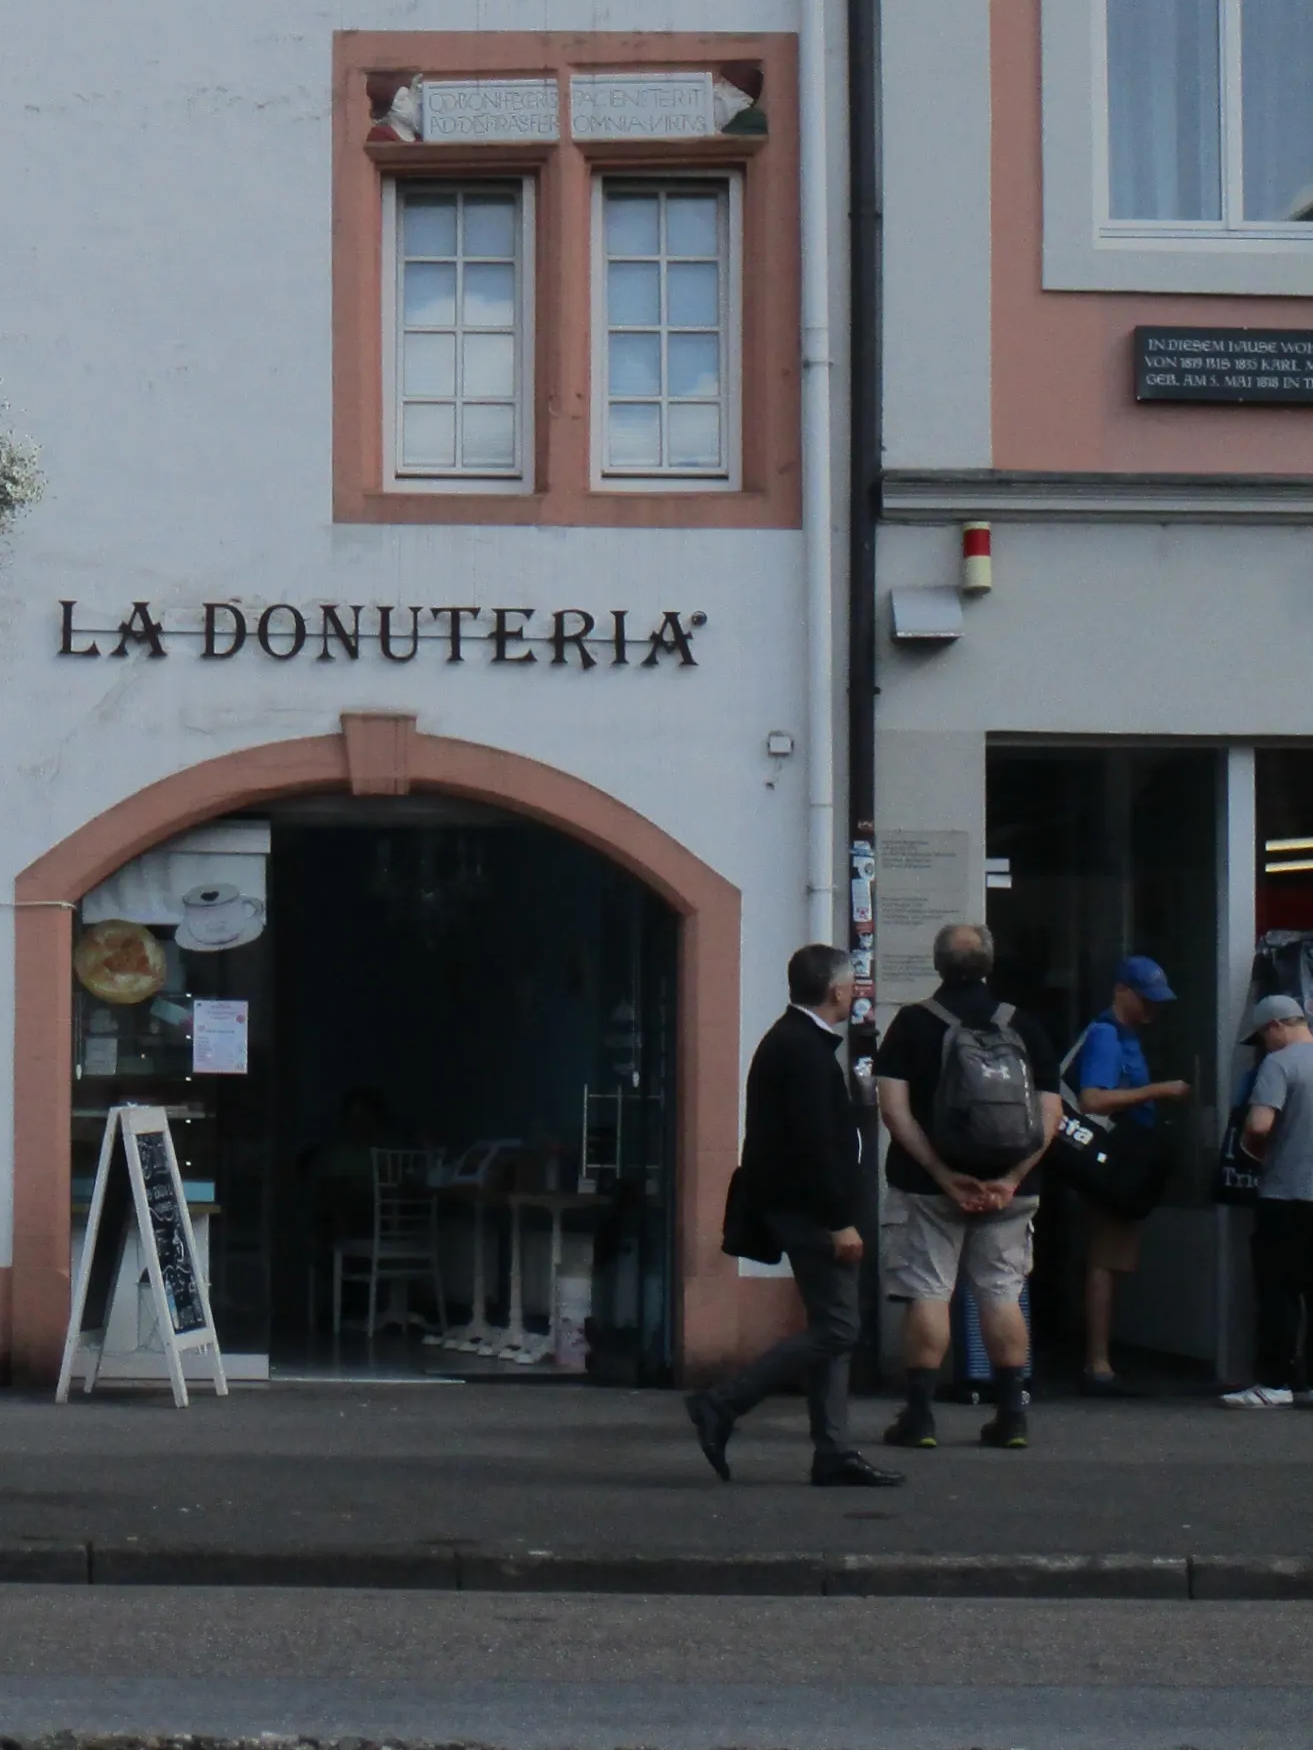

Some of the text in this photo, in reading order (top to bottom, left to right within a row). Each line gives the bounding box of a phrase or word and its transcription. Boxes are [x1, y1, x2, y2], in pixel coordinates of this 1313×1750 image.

[1148, 338, 1166, 351] IN
[1168, 338, 1225, 352] DIESEM
[1144, 355, 1178, 368] VON
[1205, 357, 1231, 370] BIS
[1260, 358, 1302, 371] KARL
[1182, 373, 1207, 386] AM
[1224, 375, 1252, 388] MAI
[1256, 376, 1279, 389] 1818
[1283, 376, 1300, 389] IN
[56, 600, 700, 670] LA DONUTERIA
